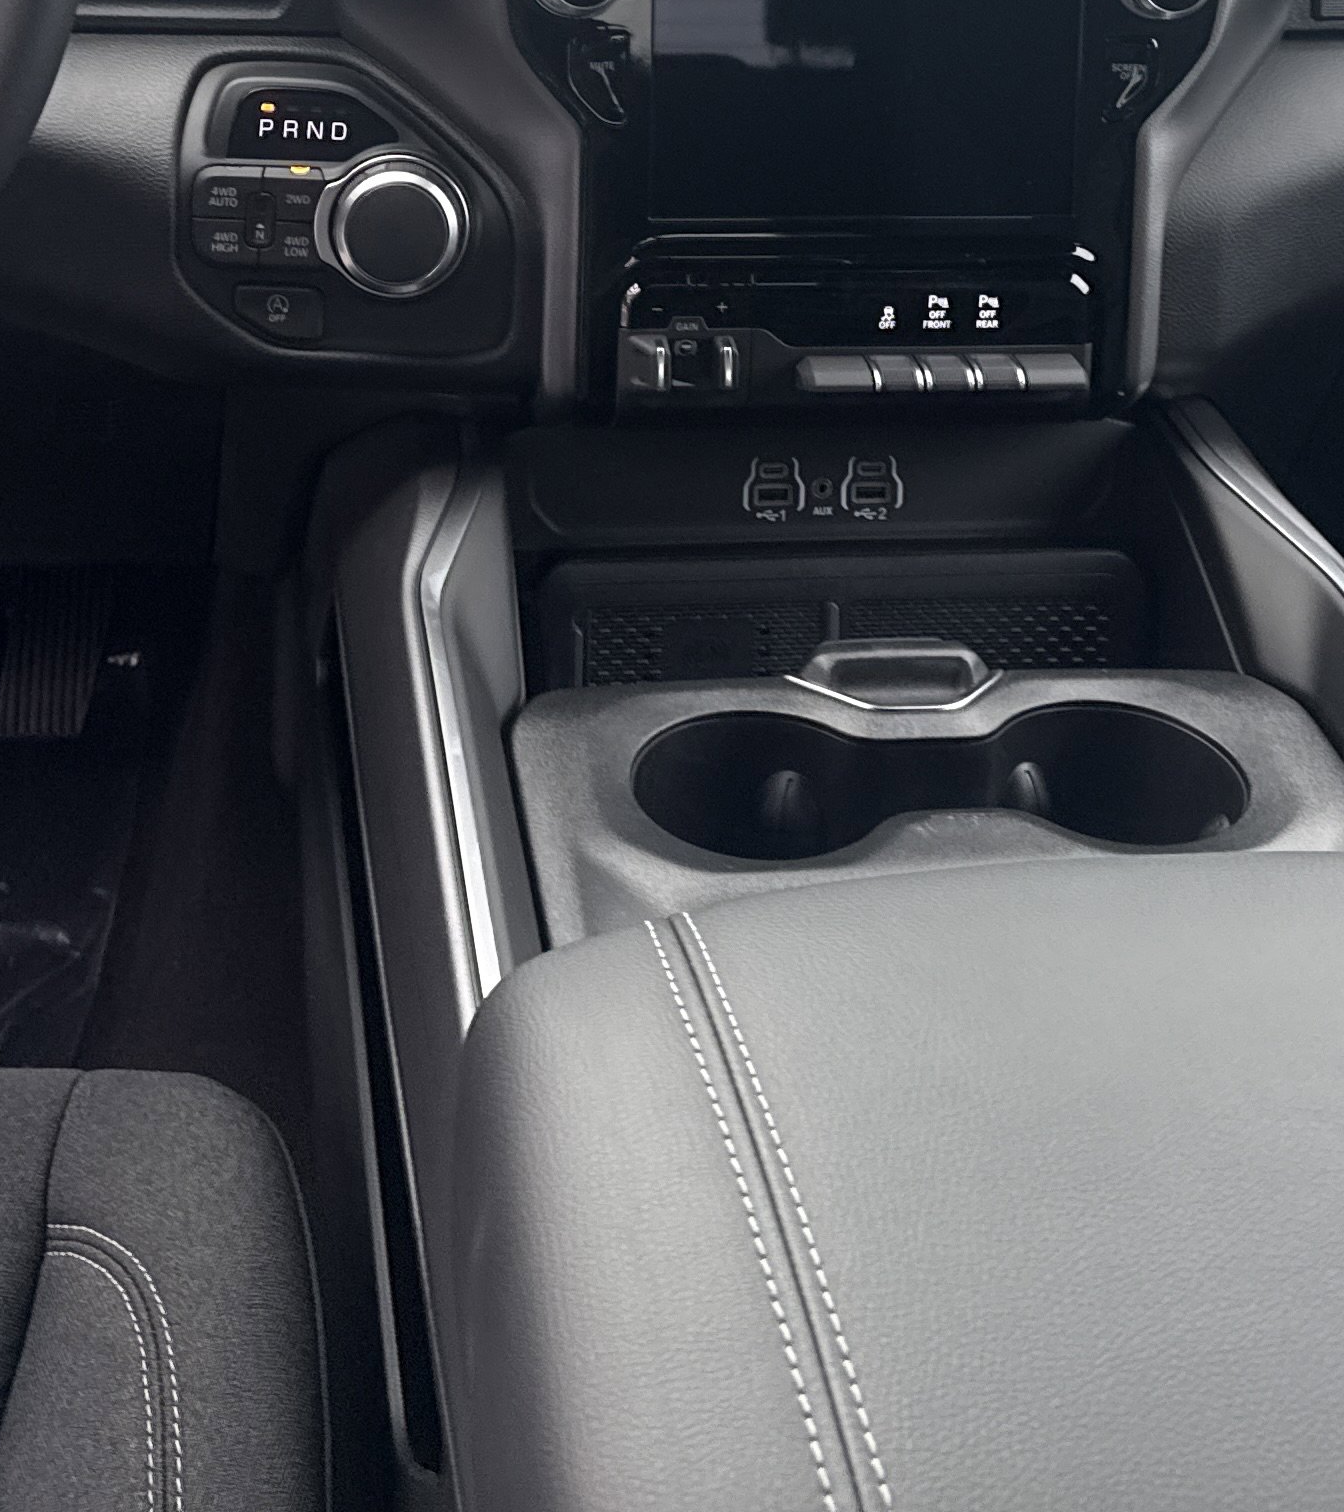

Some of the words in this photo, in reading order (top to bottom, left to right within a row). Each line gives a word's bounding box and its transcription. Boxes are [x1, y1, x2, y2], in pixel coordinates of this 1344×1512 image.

[211, 186, 237, 198] 4WD
[208, 196, 239, 208] AUTO
[284, 194, 312, 206] 2WD
[212, 232, 238, 243] 4WD
[283, 236, 310, 247] 4WD
[211, 241, 239, 253] HIGH
[284, 246, 310, 258] LOW
[268, 314, 287, 323] OFF
[928, 310, 947, 319] OFF
[978, 309, 997, 319] OFF
[878, 320, 897, 330] OFF
[922, 319, 952, 330] FRONT
[975, 319, 1000, 329] REAR
[812, 506, 834, 516] AUX
